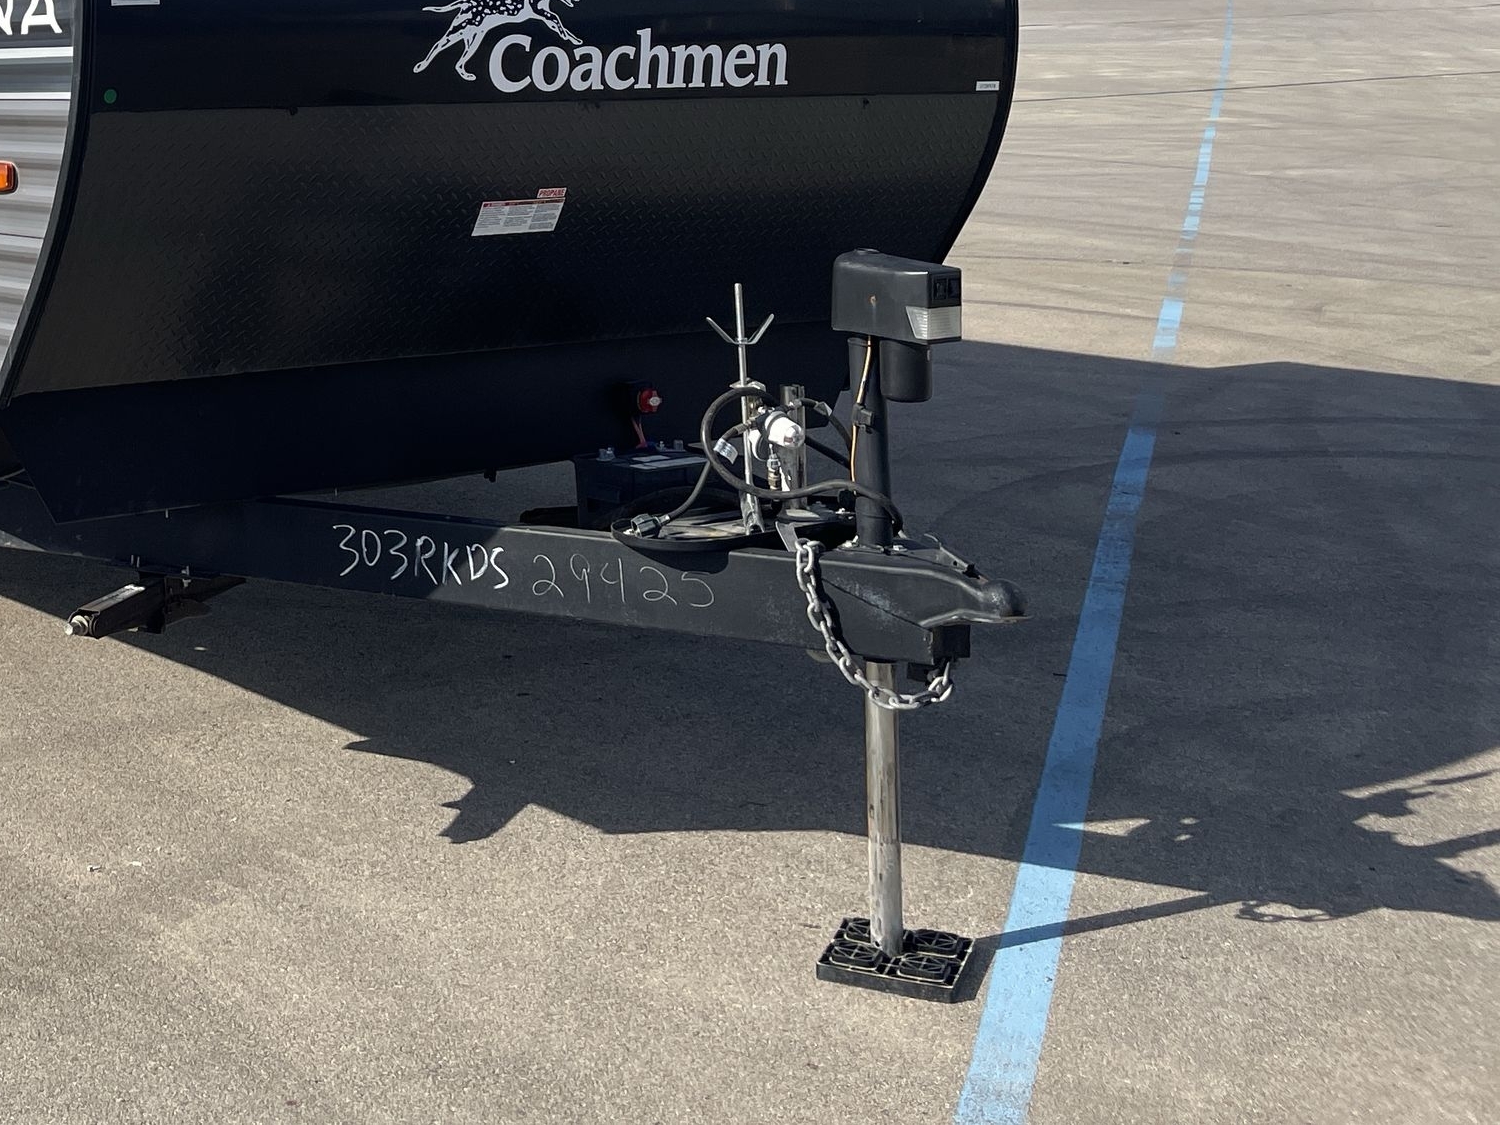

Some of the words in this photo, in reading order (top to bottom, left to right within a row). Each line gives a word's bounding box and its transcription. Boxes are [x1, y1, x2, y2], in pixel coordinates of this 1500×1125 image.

[488, 28, 788, 93] Coachmen
[332, 524, 510, 590] 303RKDS
[531, 553, 715, 607] 29425
